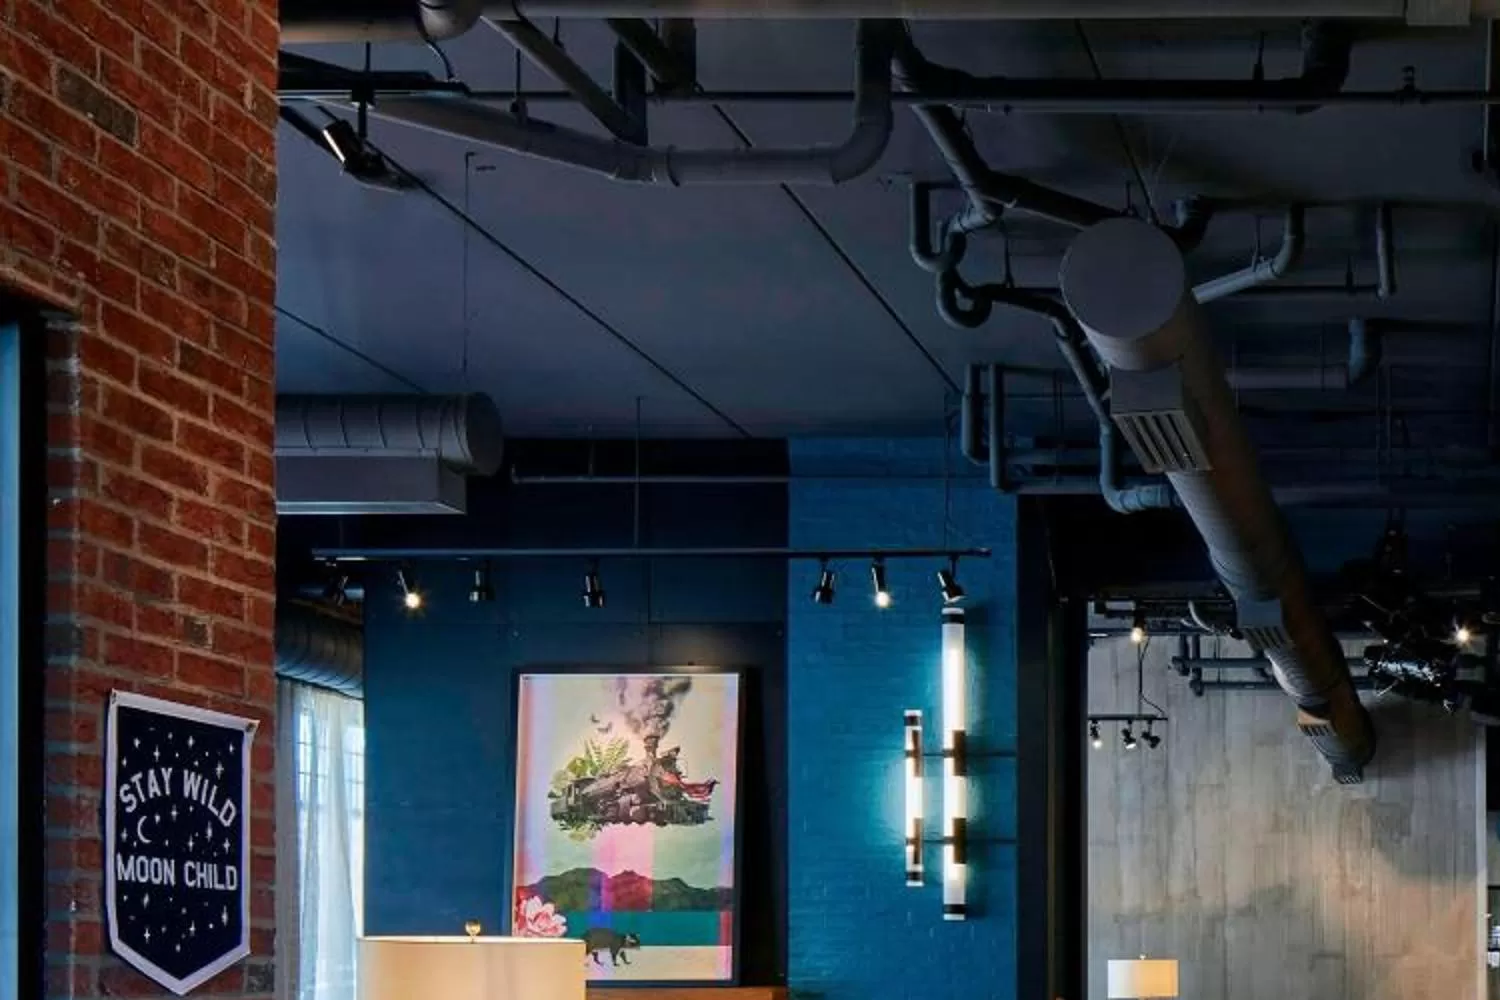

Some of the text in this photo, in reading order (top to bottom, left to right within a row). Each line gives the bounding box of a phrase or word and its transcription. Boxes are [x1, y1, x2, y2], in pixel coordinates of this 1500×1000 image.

[119, 767, 236, 827] STAY WILD
[117, 852, 237, 891] MOON CHILD
